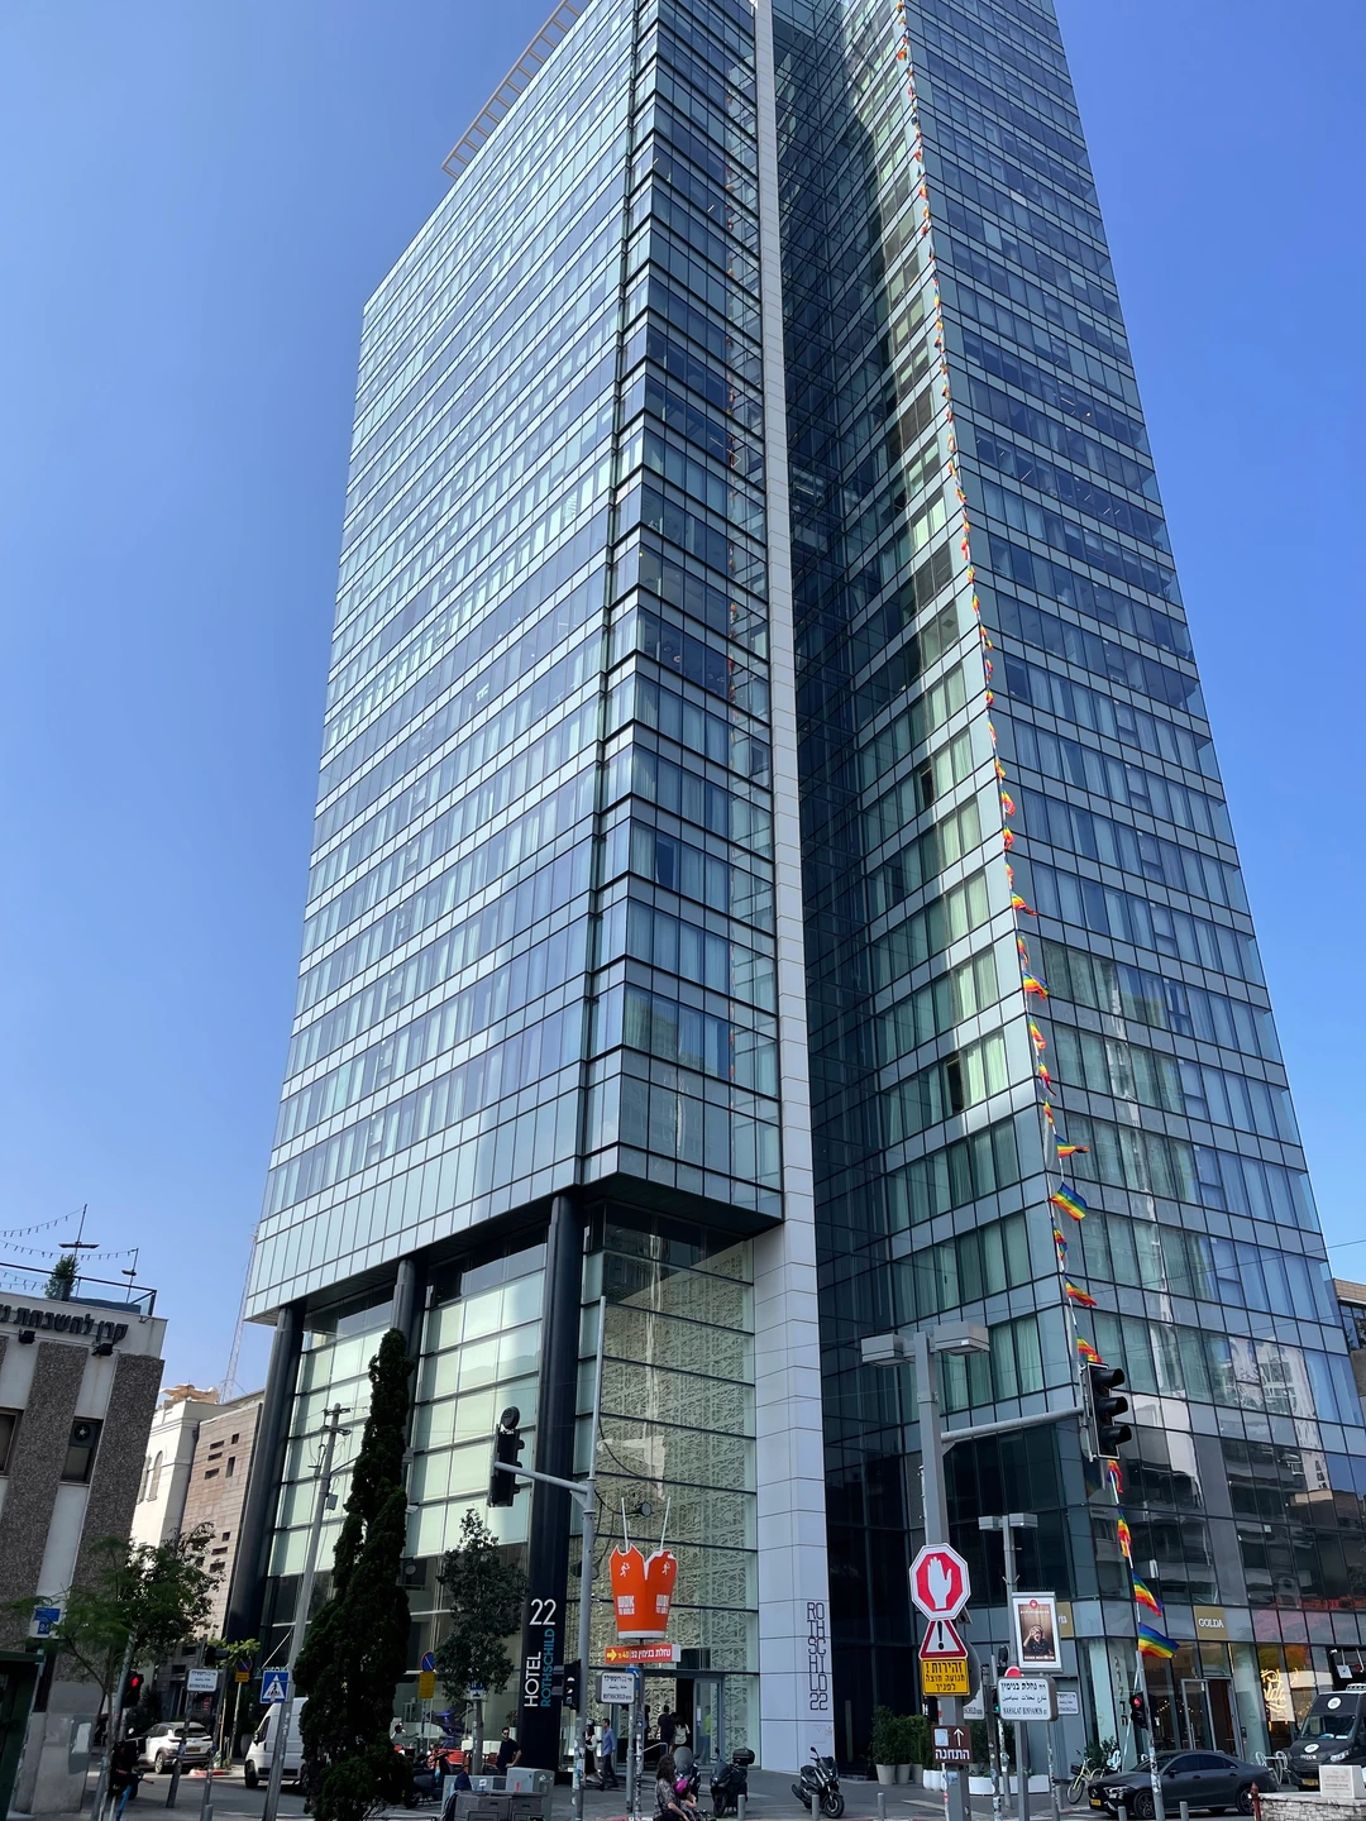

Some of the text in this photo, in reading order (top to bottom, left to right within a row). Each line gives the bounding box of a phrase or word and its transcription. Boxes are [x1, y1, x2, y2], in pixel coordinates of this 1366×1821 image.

[95, 1319, 129, 1345] קרן
[529, 1598, 557, 1625] 22
[1198, 1618, 1225, 1628] GOLDA
[524, 1651, 541, 1707] HOTEL
[541, 1628, 555, 1707] ROTHSCHILD
[810, 1692, 828, 1711] 22
[935, 1748, 970, 1760] התחנה
